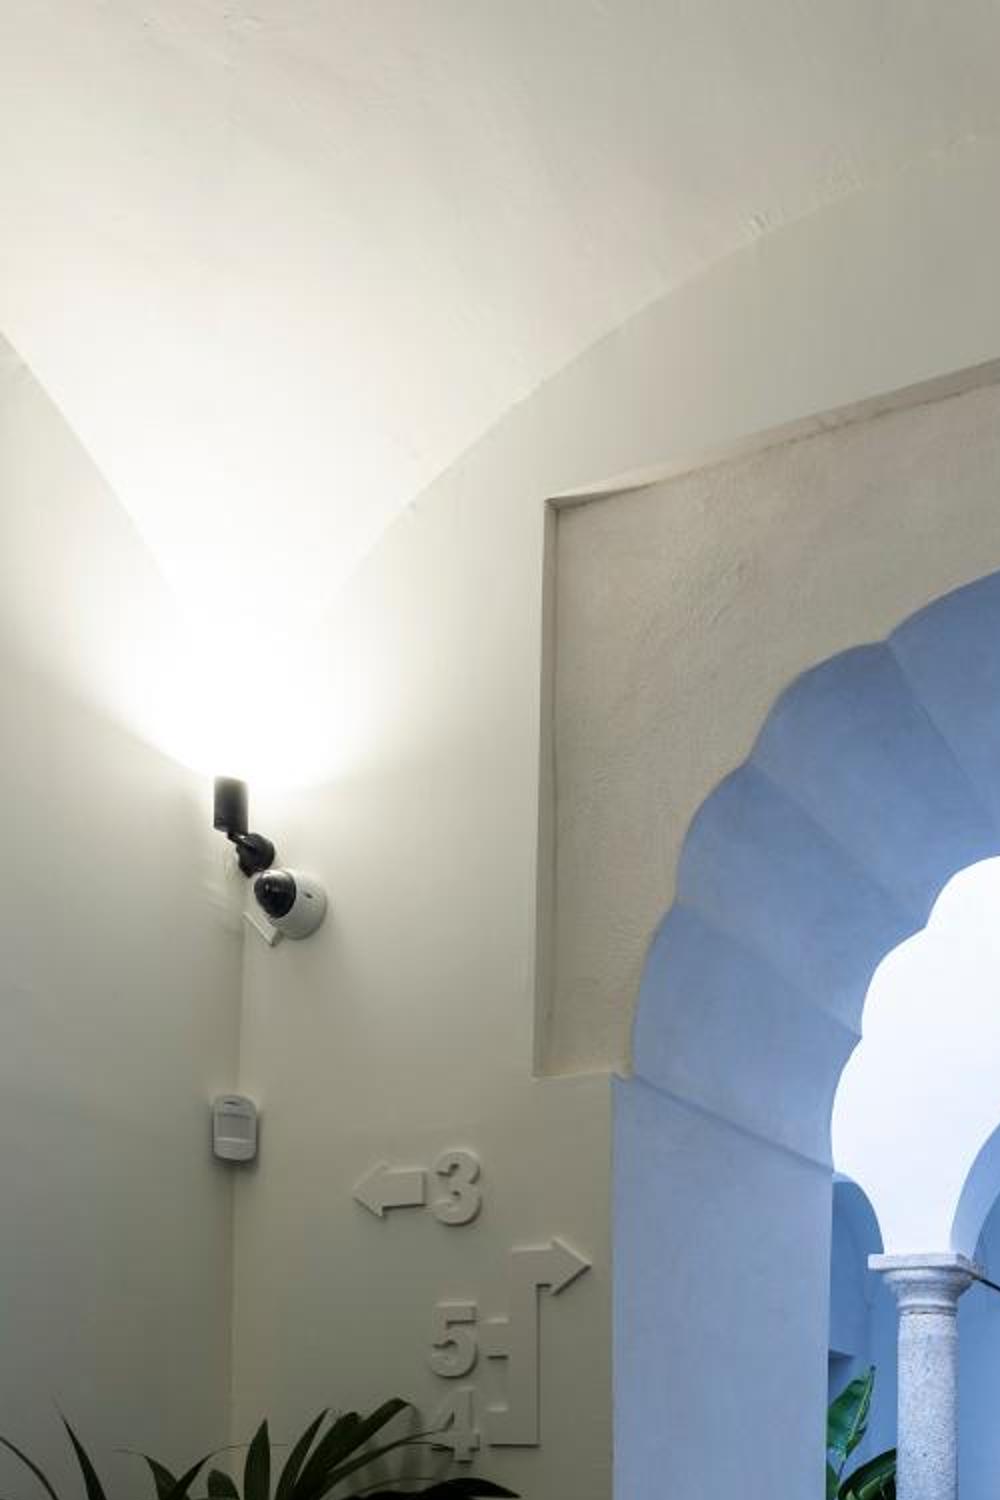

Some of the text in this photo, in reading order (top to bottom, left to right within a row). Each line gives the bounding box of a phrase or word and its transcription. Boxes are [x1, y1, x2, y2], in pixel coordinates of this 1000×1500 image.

[432, 1148, 481, 1226] 3
[431, 1301, 478, 1378] 5
[431, 1386, 480, 1463] 4
